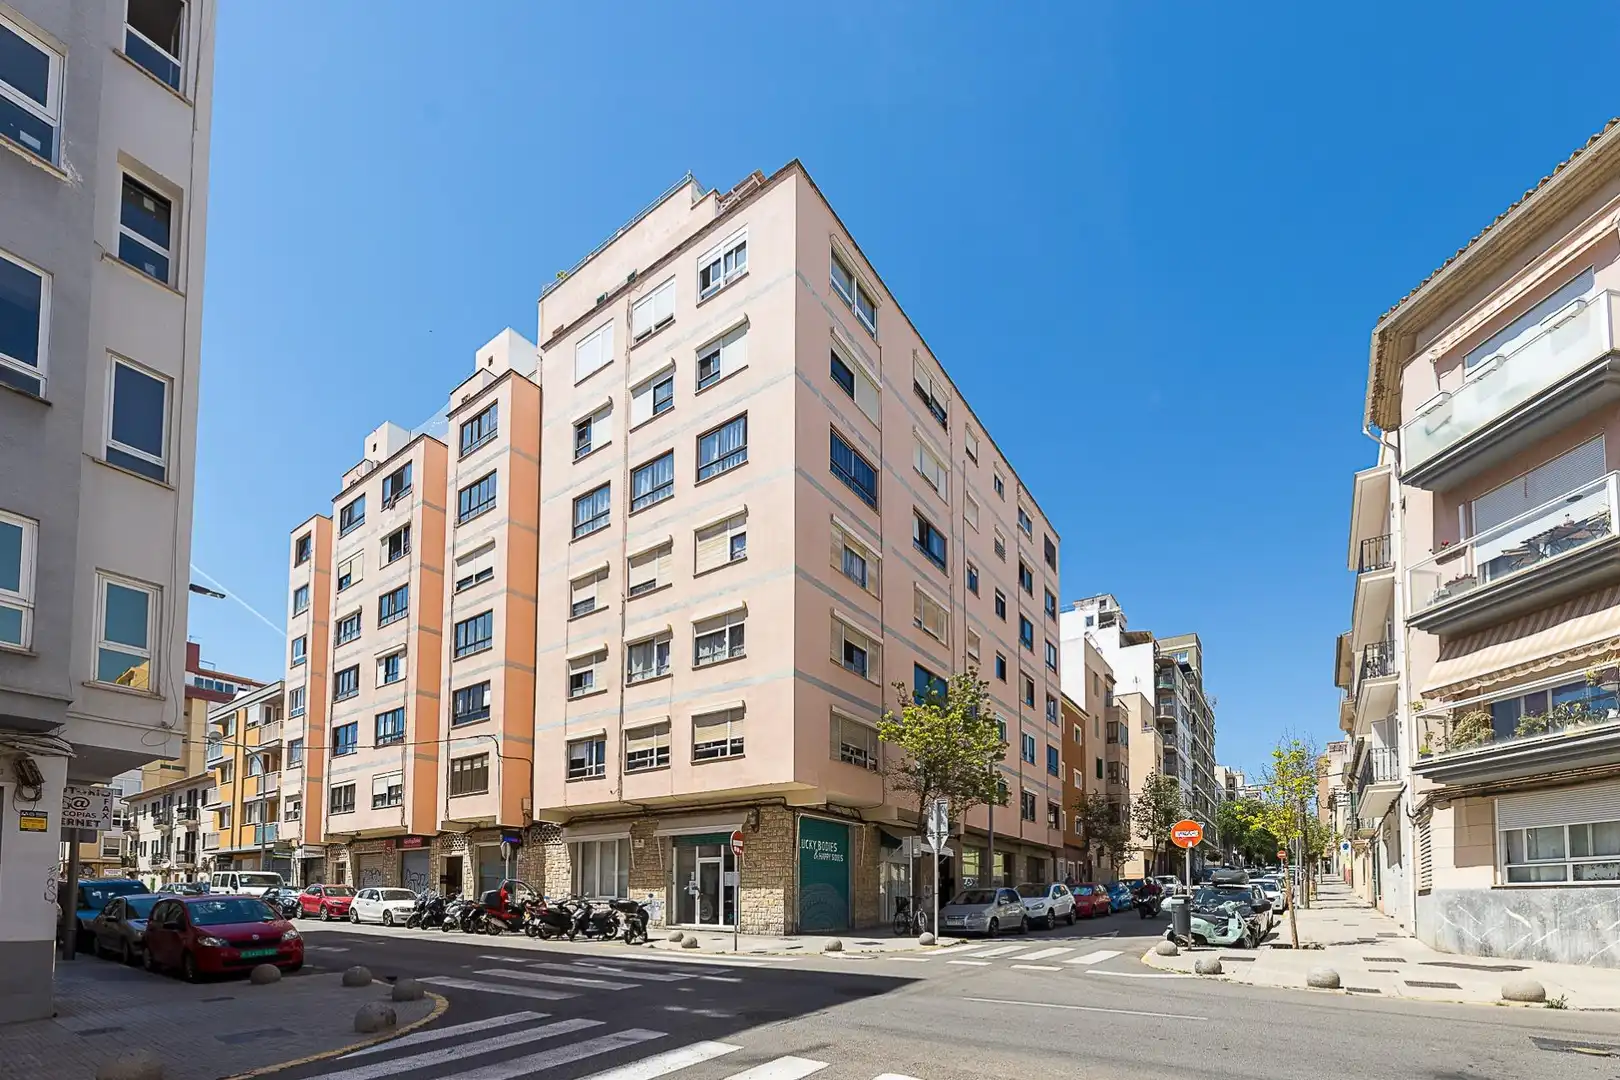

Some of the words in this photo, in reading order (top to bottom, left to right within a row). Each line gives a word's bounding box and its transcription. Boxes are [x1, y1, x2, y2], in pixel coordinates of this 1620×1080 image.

[62, 810, 97, 818] COPIAS
[102, 799, 110, 820] FAX
[818, 840, 838, 852] BODIES
